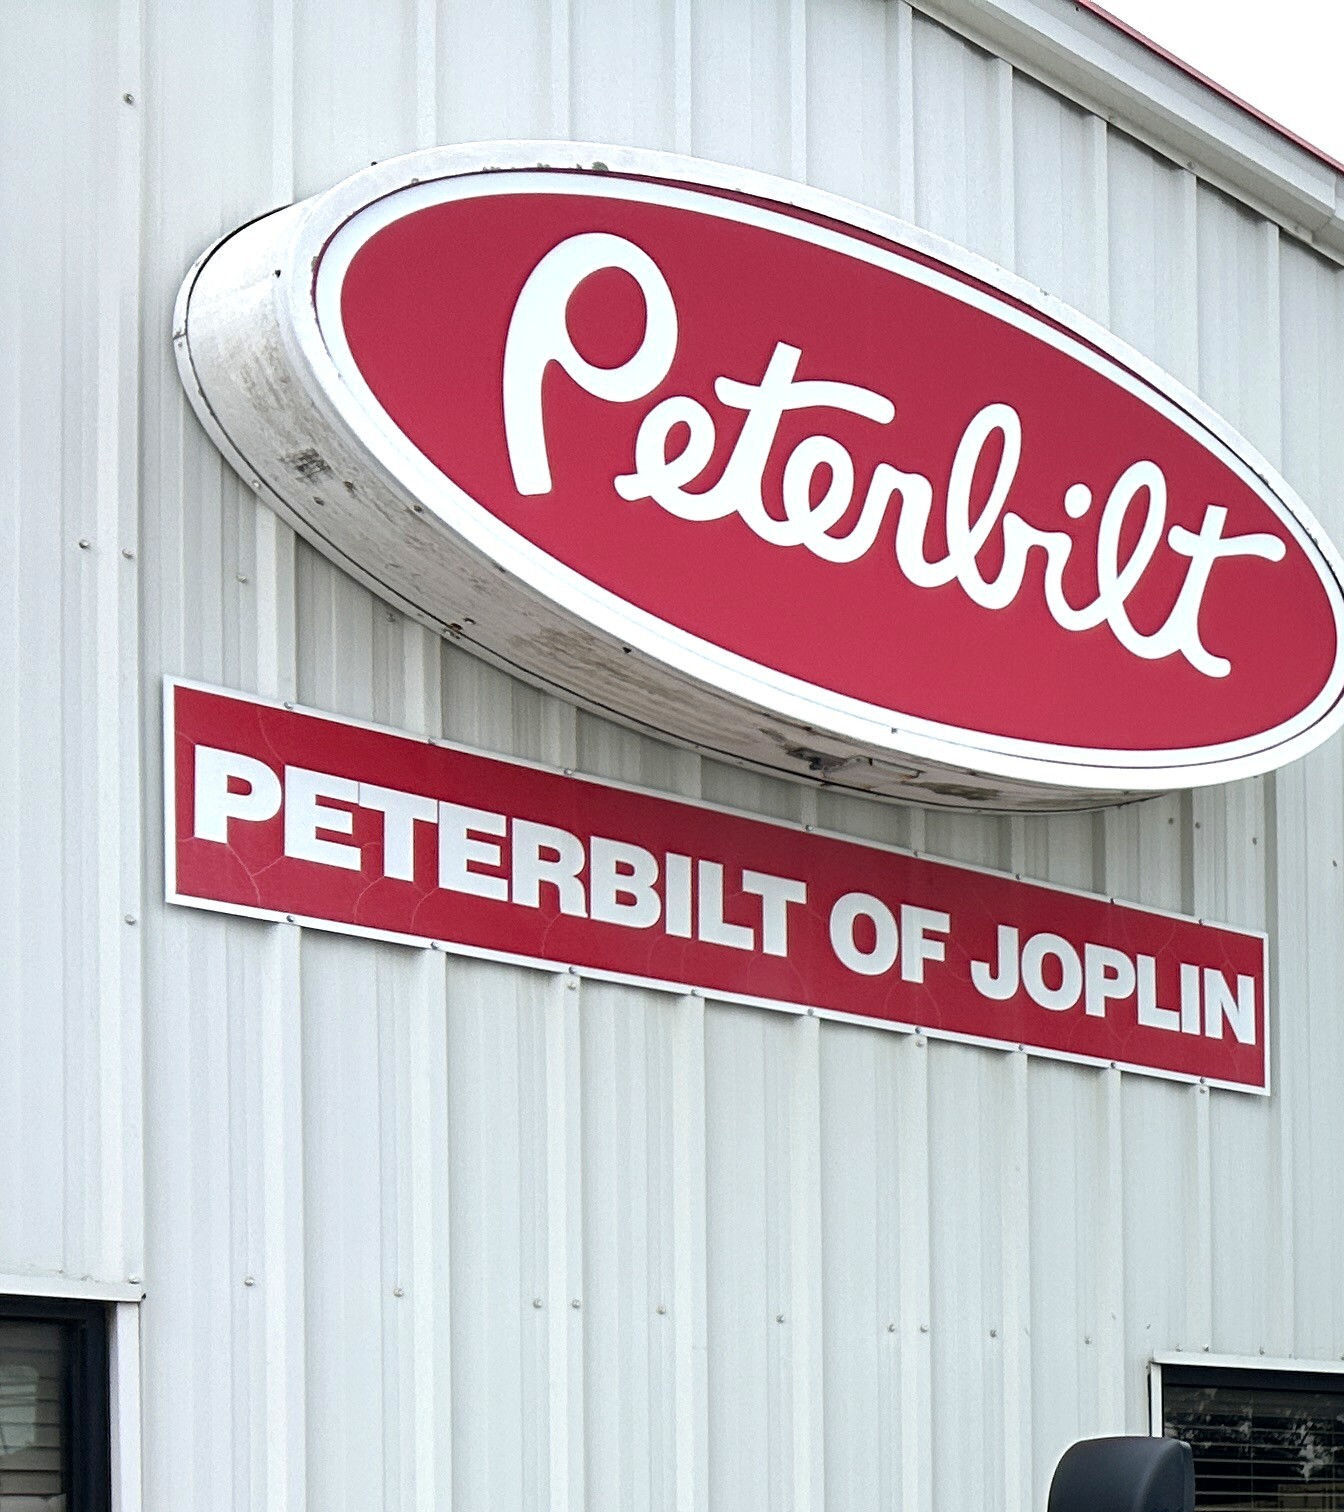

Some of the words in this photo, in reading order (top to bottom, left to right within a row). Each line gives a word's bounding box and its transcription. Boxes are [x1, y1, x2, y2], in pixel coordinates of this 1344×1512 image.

[503, 233, 1286, 677] Peterbilt
[194, 745, 806, 957] PETERBILT
[830, 893, 949, 983] OF
[971, 925, 1255, 1045] JOPLIN
